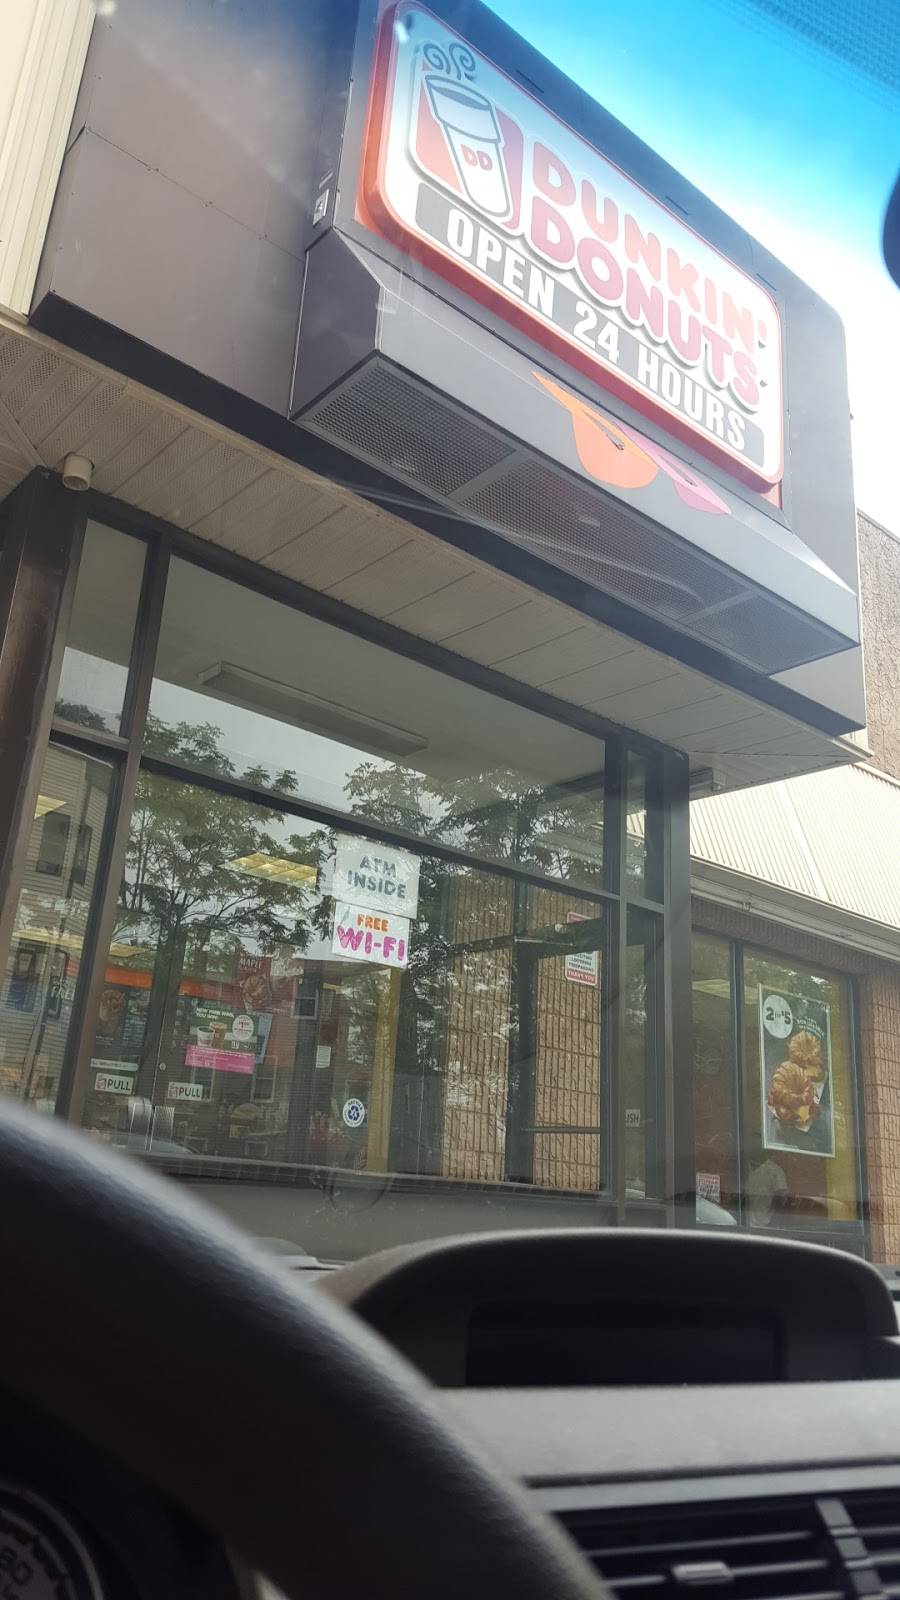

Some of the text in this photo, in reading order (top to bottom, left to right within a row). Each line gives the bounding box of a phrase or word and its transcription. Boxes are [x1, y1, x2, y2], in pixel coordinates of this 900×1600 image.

[461, 145, 493, 172] DD
[533, 140, 766, 353] DUNKIN'
[531, 197, 760, 406] DONUTS
[446, 210, 745, 450] OPEN 24 HOURS
[360, 856, 396, 878] ATM
[348, 870, 406, 899] INSIDE
[357, 914, 388, 931] FREE
[337, 926, 405, 960] WI-FI
[766, 1007, 775, 1022] 2
[107, 1079, 129, 1091] PULL
[179, 1088, 200, 1098] PULL
